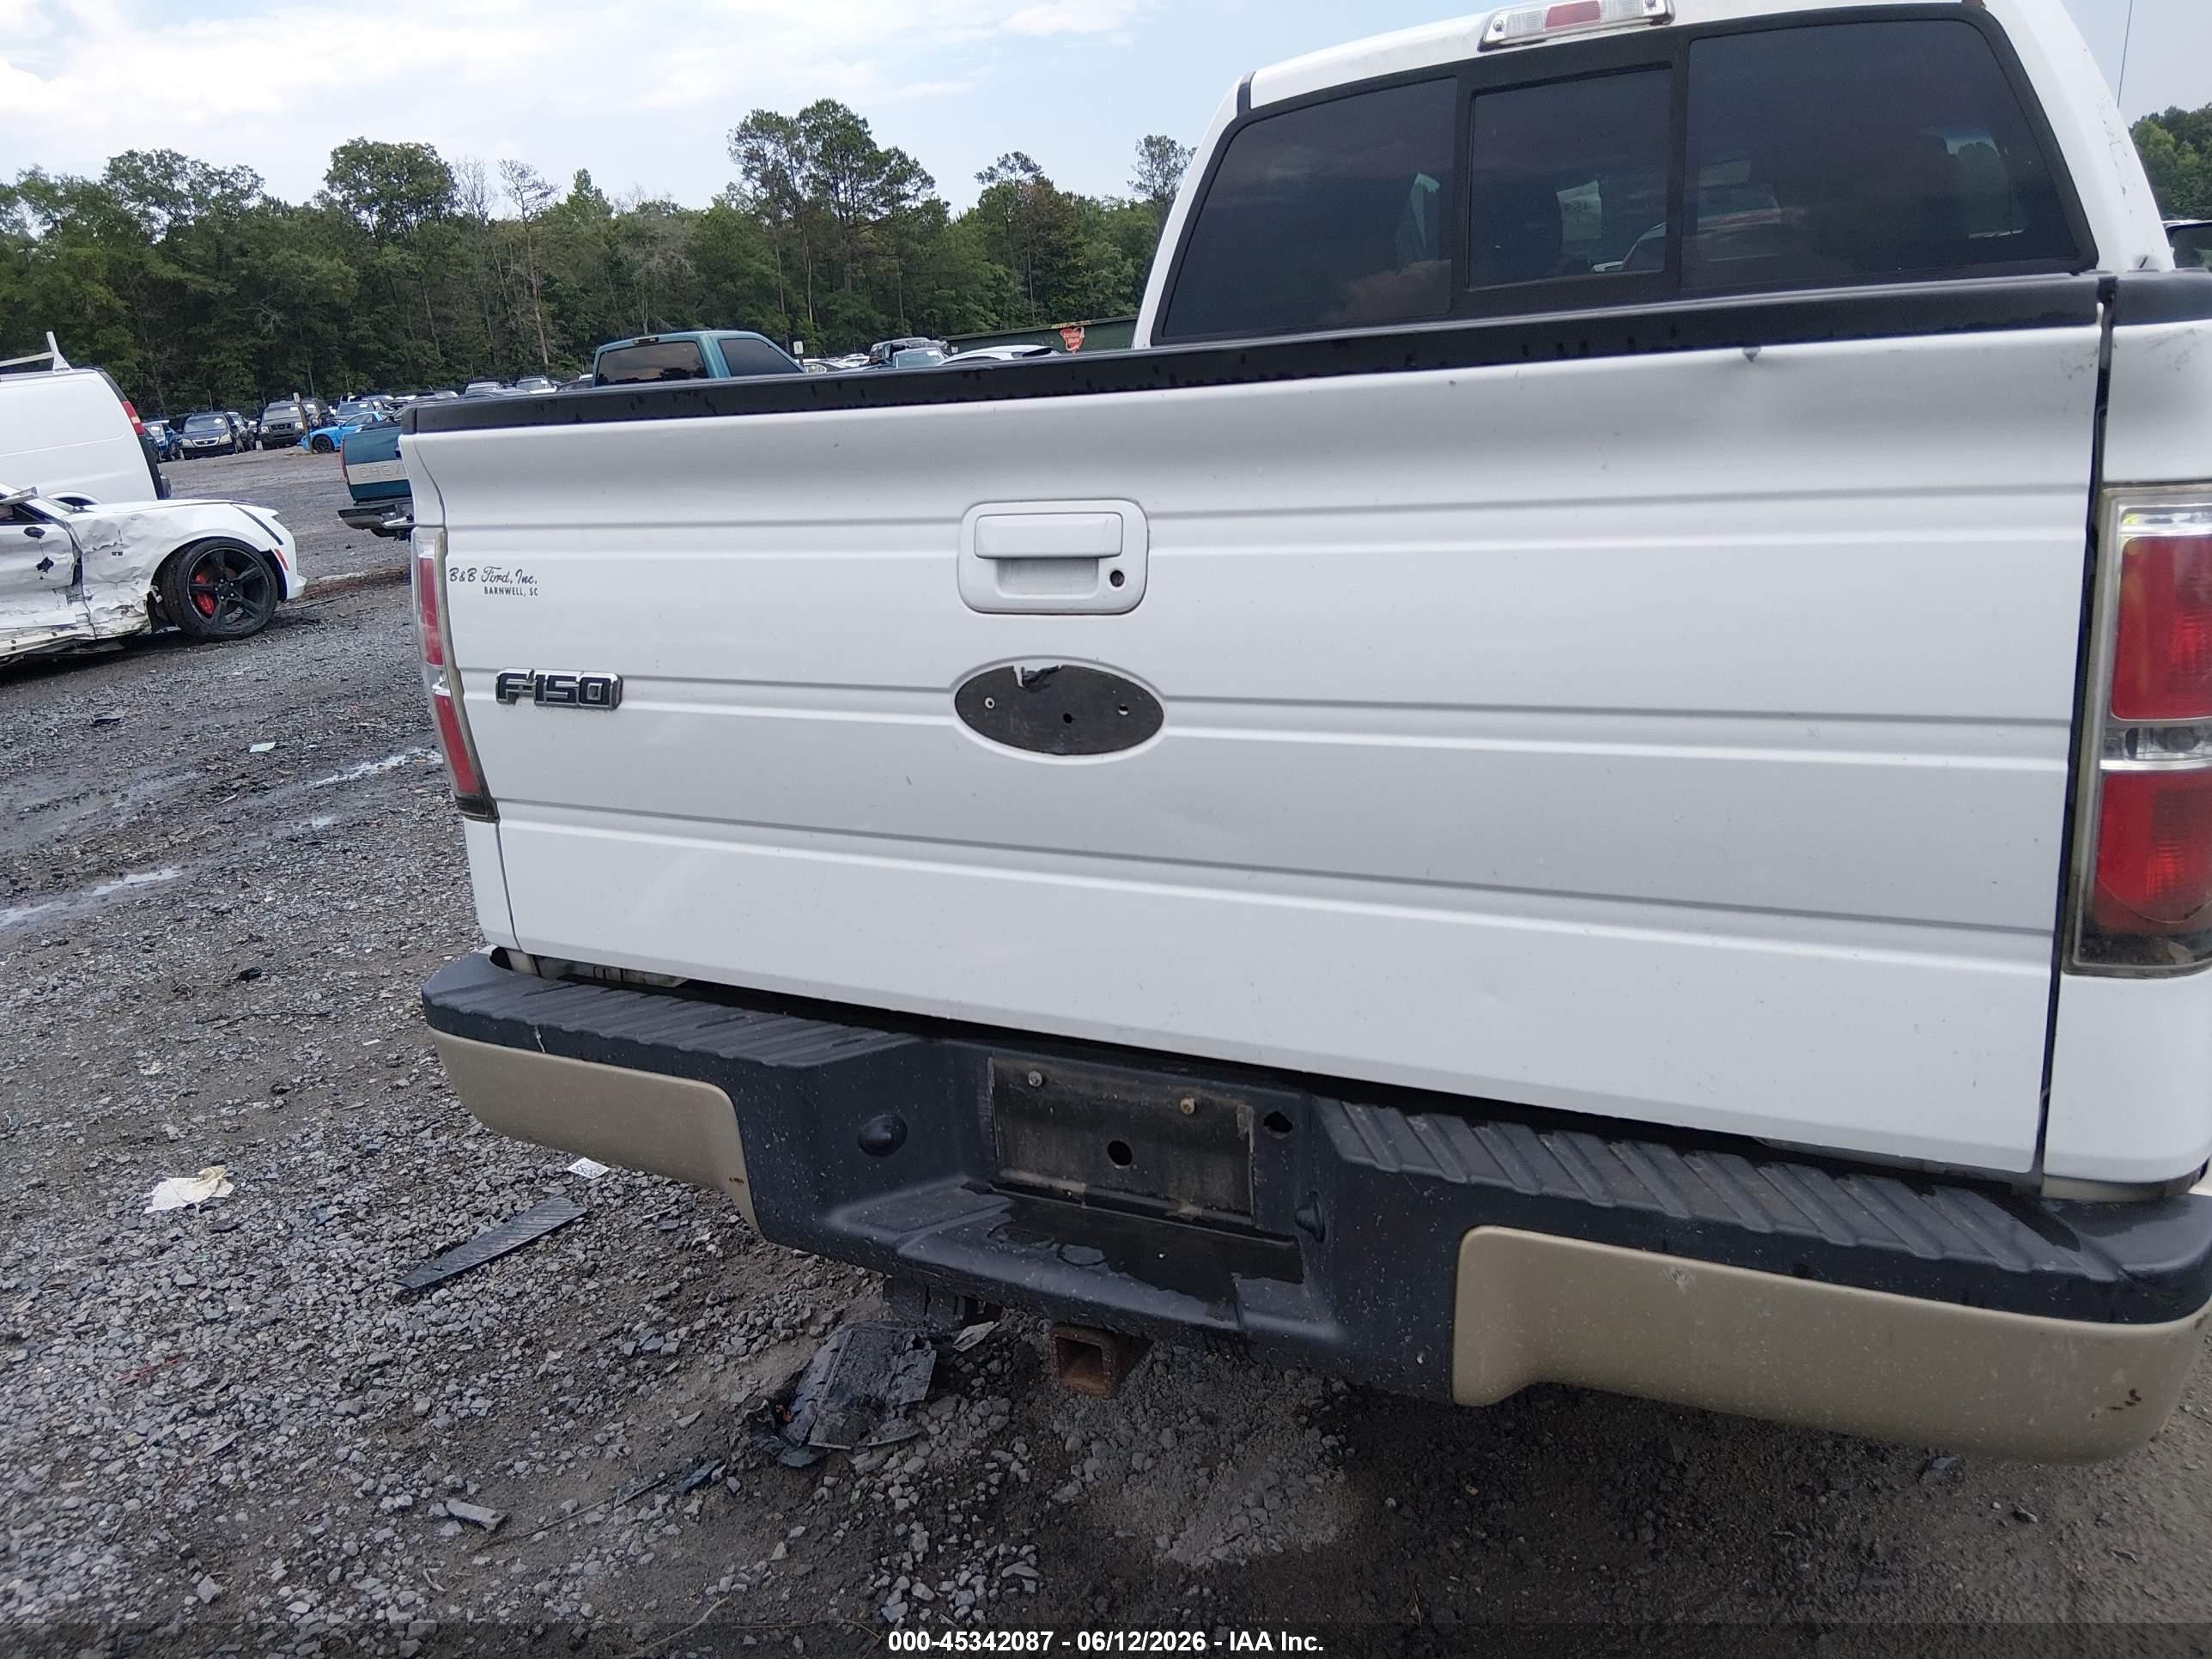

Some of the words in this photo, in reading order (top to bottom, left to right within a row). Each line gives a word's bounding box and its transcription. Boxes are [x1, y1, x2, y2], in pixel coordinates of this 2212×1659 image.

[449, 567, 477, 582] B&B
[515, 568, 538, 584] Inc.
[484, 586, 526, 597] BARNWELL,
[529, 587, 538, 596] SC
